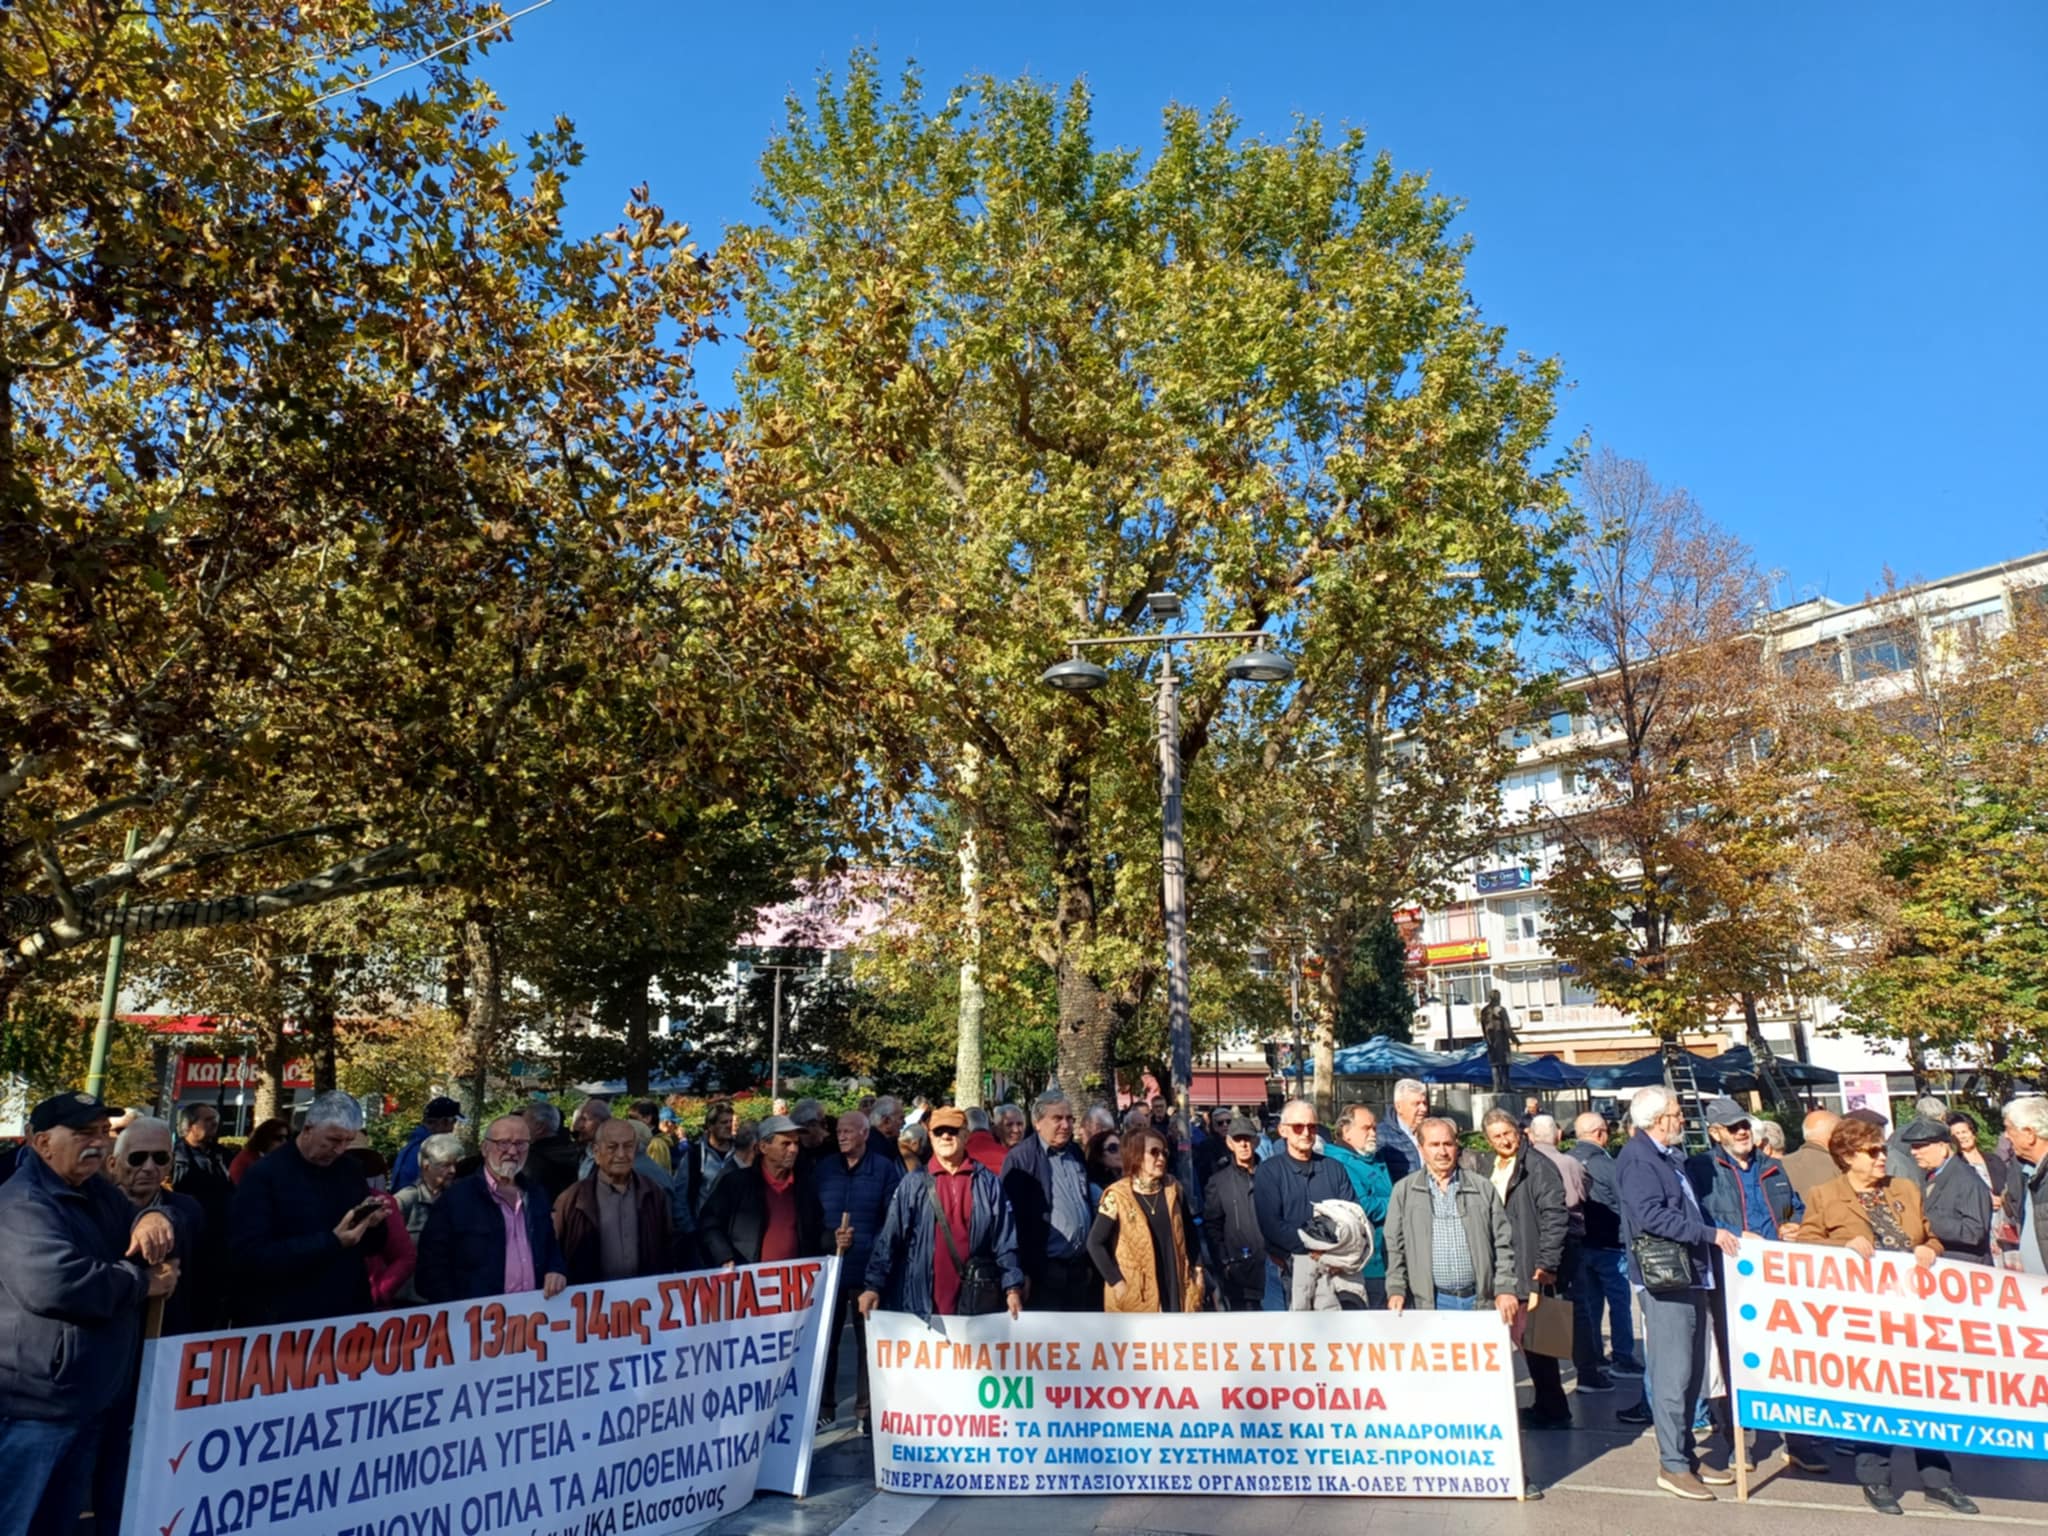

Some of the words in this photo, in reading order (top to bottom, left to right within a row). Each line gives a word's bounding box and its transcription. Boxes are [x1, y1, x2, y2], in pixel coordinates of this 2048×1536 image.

[1762, 1250, 2027, 1312] ΕΠΑΝΑΦΟΡΑ
[175, 1310, 454, 1410] ΕΠΑΝΑΦΟΡΑ
[658, 1263, 821, 1331] ΣΥΝΤΑΞΗΣ
[876, 1340, 1081, 1371] ΠΡΑΓΜΑΤΙΚΕΣ
[1091, 1342, 1239, 1371] ΑΥΞΗΣΕΙΣ
[1250, 1343, 1316, 1372] ΣΤΙΣ
[1328, 1343, 1501, 1372] ΣΥΝΤΑΞΕΙΣ
[1766, 1299, 2048, 1360] ΑΥΞΗΣΕΙΣ
[978, 1376, 1033, 1409] ΟΧΙ
[1045, 1386, 1199, 1410] ΨΙΧΟΥΛΑ
[1221, 1383, 1387, 1410] ΚΟΡΟΪΔΙΑ
[1768, 1347, 2048, 1409] ΑΠΟΚΛΕΙΣΤΙΚΑ
[198, 1389, 443, 1473] ΟΥΣΙΑΣΤΙΚΕΣ
[450, 1361, 600, 1422] ΑΥΞΗΣΕΙΣ
[609, 1350, 667, 1392] ΣΤΙΣ
[880, 1410, 1008, 1438] ΑΠΑΙΤΟΥΜΕ:
[1015, 1421, 1041, 1438] ΤΑ
[1047, 1421, 1174, 1438] ΠΛΗΡΩΜΕΝΑ
[1180, 1422, 1234, 1439] ΔΩΡΑ
[1240, 1422, 1282, 1439] ΜΑΣ
[1290, 1422, 1324, 1439] ΚΑΙ
[1331, 1423, 1357, 1439] ΤΑ
[1364, 1423, 1503, 1440] ΑΝΑΔΡΟΜΙΚΑ
[188, 1467, 340, 1536] ΔΩΡΕΑΝ
[348, 1436, 487, 1504] ΔΗΜΟΣΙΑ
[495, 1419, 574, 1468] ΥΓΕΙΑ
[597, 1393, 694, 1446] ΔΩΡΕΑΝ
[461, 1483, 543, 1536] ΟΠΛΑ
[550, 1472, 585, 1513] ΤΑ
[592, 1430, 760, 1503] ΑΠΟΘΕΜΑΤΙΚΑ
[881, 1467, 1029, 1490] ΣΥΝΕΡΓΑΖΟΜΕΝΕΣ
[1036, 1474, 1192, 1490] ΣΥΝΤΑΞΙΟΥΧΙΚΕΣ
[1199, 1475, 1311, 1491] ΟΡΓΑΝΩΣΕΙΣ
[1318, 1476, 1407, 1493] ΙΚΑ-ΟΑΕΕ
[1413, 1476, 1510, 1493] ΤΥΡΝΑΒΟΥ
[892, 1444, 991, 1463] ΕΝΙΣΧΥΣΗ
[997, 1446, 1037, 1463] ΤΟΥ
[1044, 1447, 1152, 1464] ΔΗΜΟΣΙΟΥ
[1160, 1447, 1298, 1464] ΣΥΣΤΗΜΑΤΟΣ
[1305, 1448, 1495, 1466] ΥΓΕΙΑΣ-ΠΡΟΝΟΙΑΣ
[583, 1508, 616, 1536] ΙΚΑ
[623, 1484, 727, 1532] Ελασσόνας
